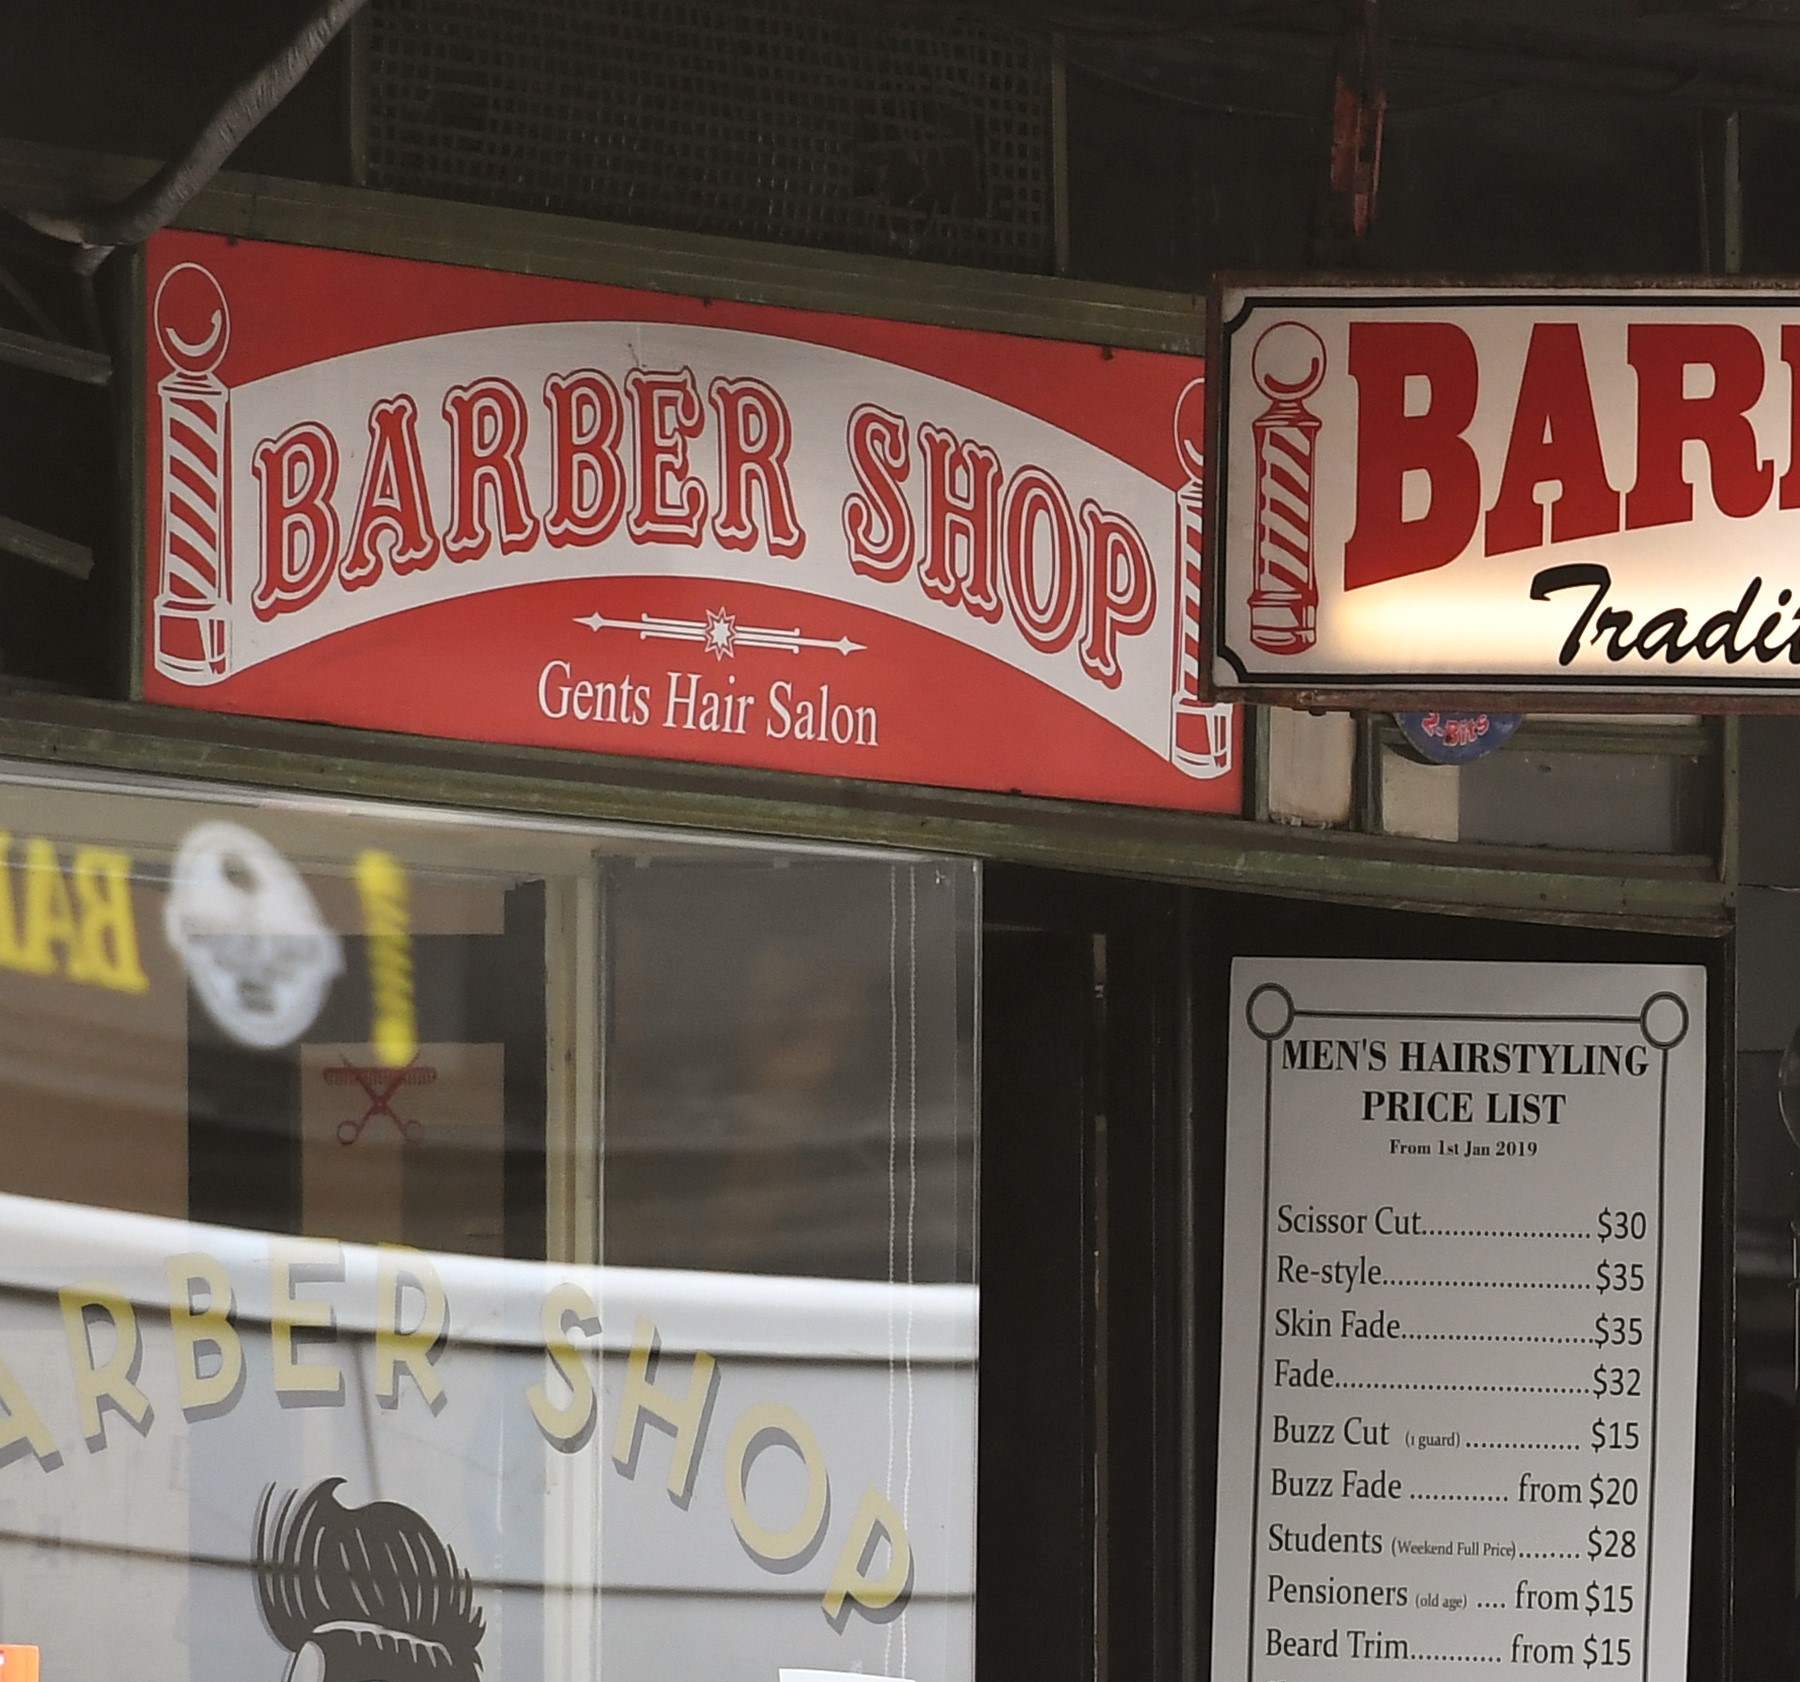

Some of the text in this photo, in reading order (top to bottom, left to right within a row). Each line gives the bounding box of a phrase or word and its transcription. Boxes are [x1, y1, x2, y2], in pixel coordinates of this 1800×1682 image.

[250, 364, 1158, 688] BARBER SHOP
[536, 660, 879, 747] Gents Hair Salon
[1282, 1038, 1649, 1077] MEN'S HAIRSTYLING
[1361, 1090, 1566, 1125] PRICE LIST
[1389, 1138, 1538, 1157] From 1st Jan 2019
[1277, 1203, 1367, 1235] Scissor
[1597, 1207, 1647, 1243] $30
[1277, 1255, 1645, 1295] Re-style $35
[1275, 1308, 1643, 1349] Skin Fade $35
[1274, 1359, 1641, 1400] Fade $32
[1273, 1415, 1335, 1445] Buzz
[1344, 1417, 1390, 1446] Cut
[1591, 1417, 1640, 1453] $15
[526, 1281, 913, 1636] SHOP
[1271, 1468, 1638, 1509] Buzz Fade from $20
[1268, 1523, 1383, 1555] Students
[1456, 1540, 1479, 1557] Full
[1587, 1526, 1636, 1562] $28
[1267, 1575, 1408, 1607] Pensioners
[1515, 1580, 1579, 1612] from
[1584, 1580, 1634, 1616] $15
[1265, 1628, 1631, 1669] Beard Trim from $15
